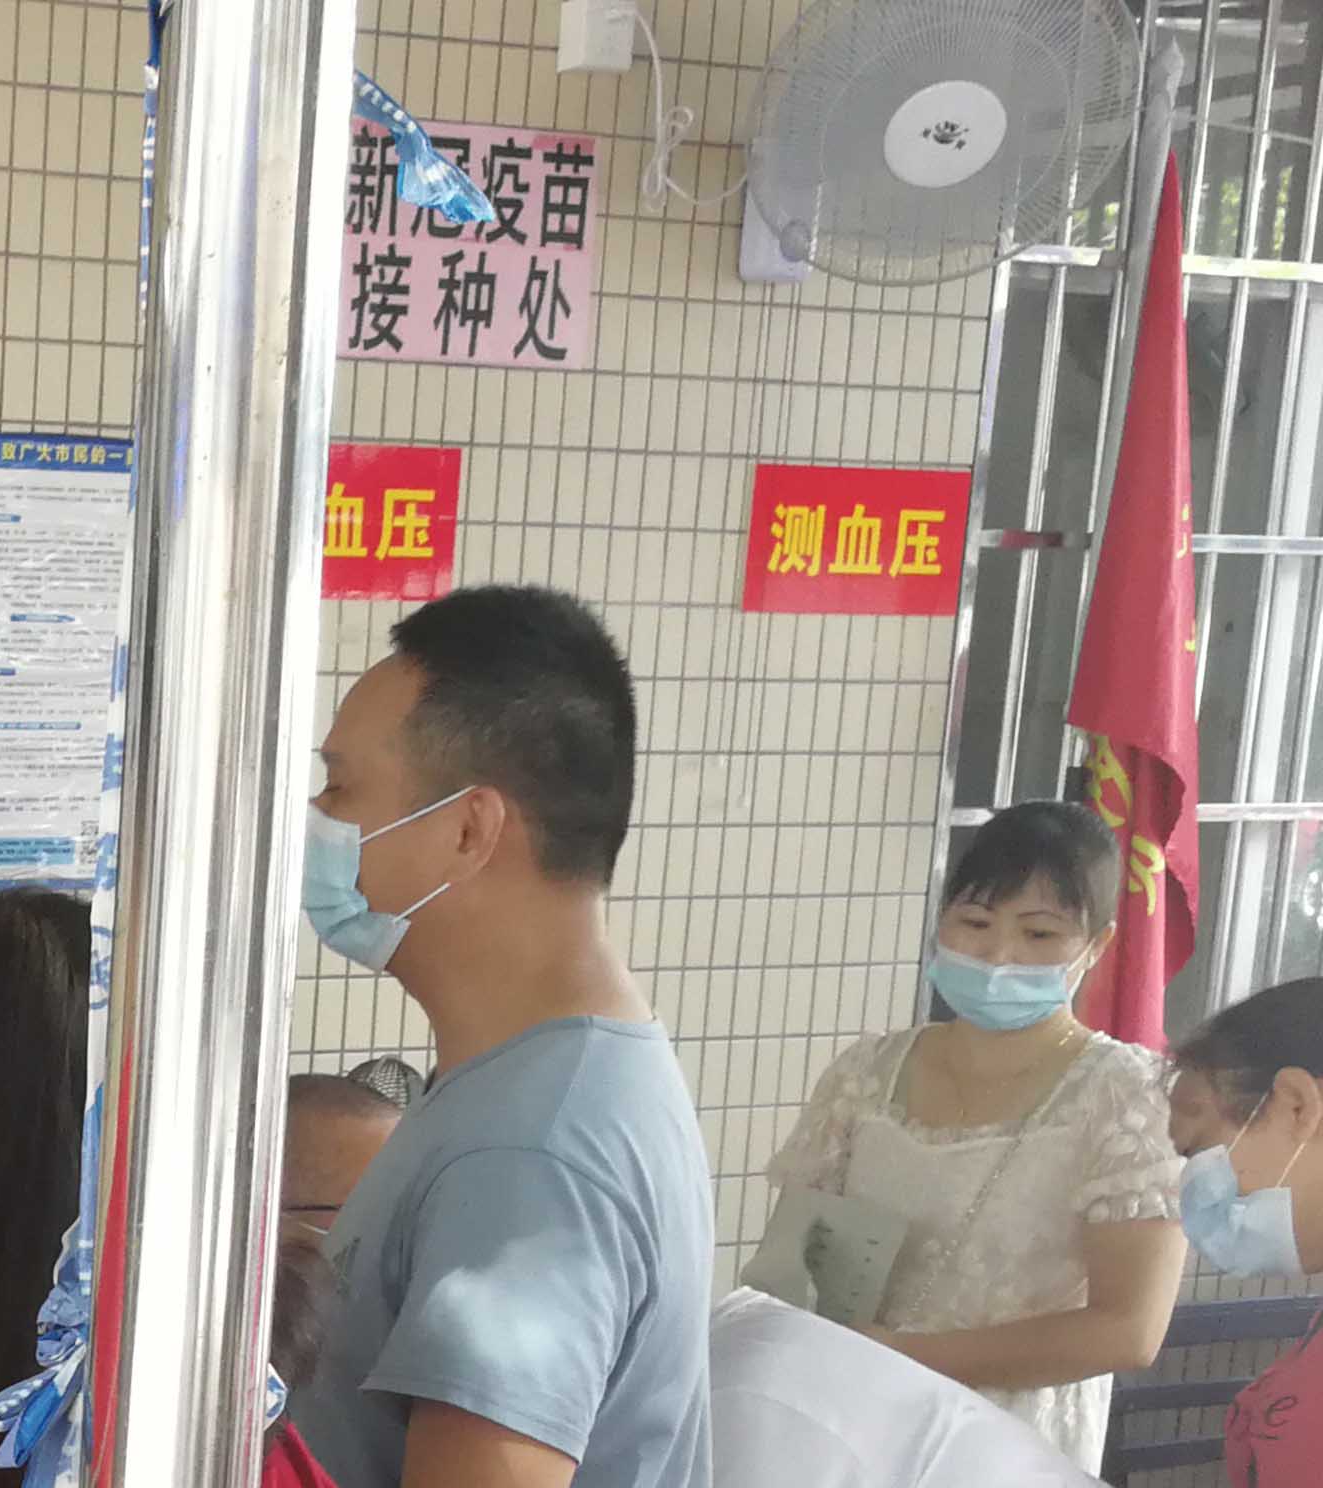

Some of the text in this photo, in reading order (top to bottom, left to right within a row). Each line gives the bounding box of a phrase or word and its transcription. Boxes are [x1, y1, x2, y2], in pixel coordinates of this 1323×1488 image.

[347, 241, 572, 361] 接种处
[768, 503, 947, 579] 测血压
